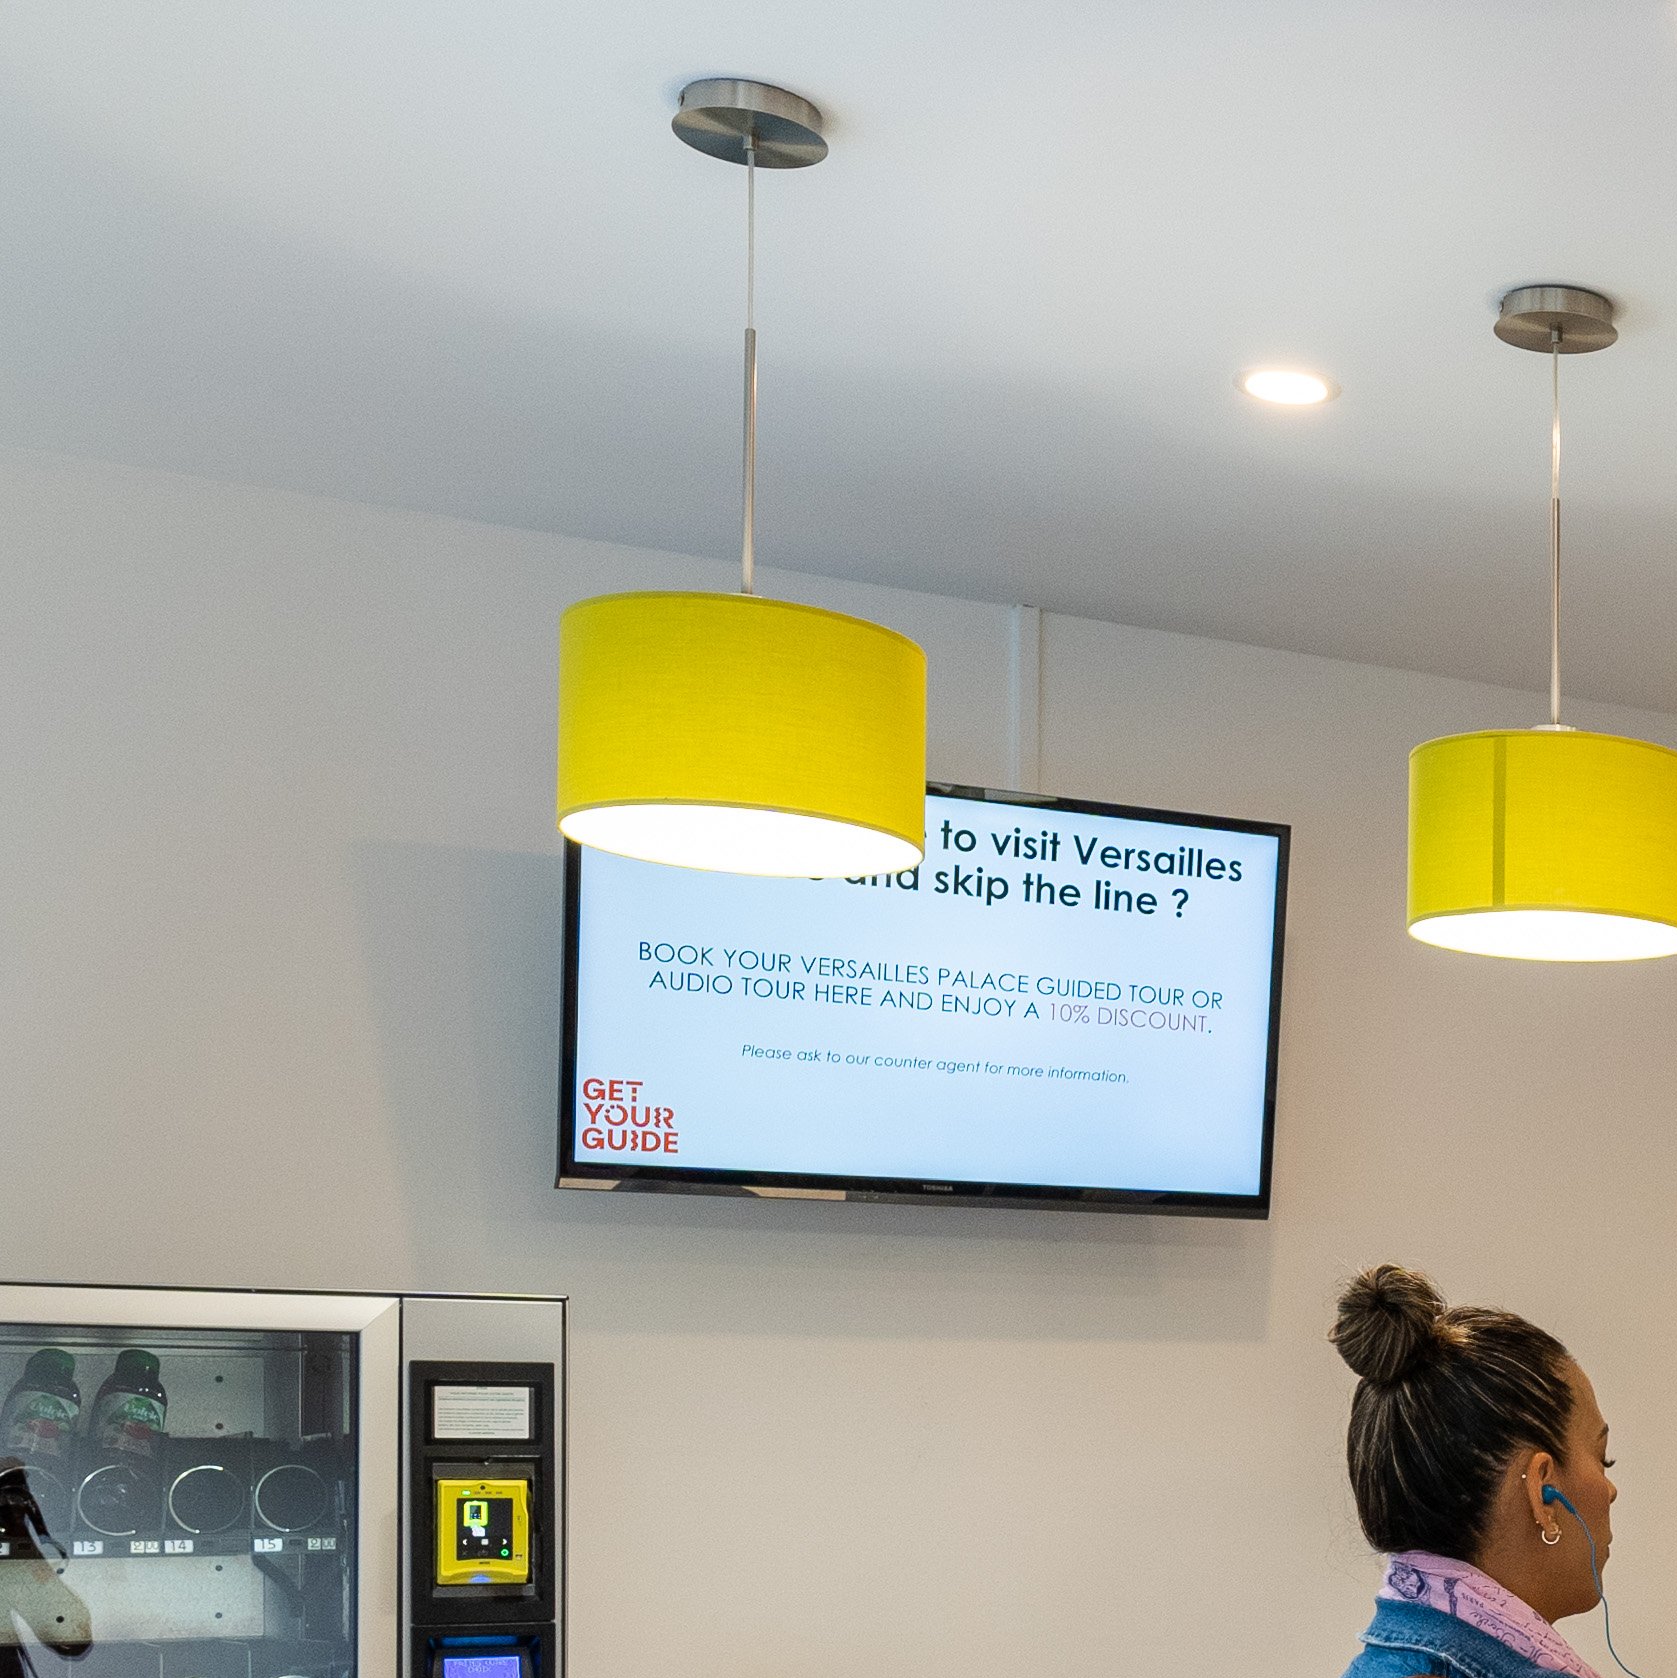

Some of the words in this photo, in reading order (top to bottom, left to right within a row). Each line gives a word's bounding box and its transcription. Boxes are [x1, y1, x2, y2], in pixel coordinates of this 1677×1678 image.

[941, 820, 976, 852] to
[991, 827, 1061, 865] visit
[1073, 835, 1243, 882] Versailles
[934, 865, 1009, 906] skip
[1023, 873, 1081, 907] the
[1094, 881, 1158, 915] line
[1172, 888, 1189, 918] ?
[639, 941, 714, 966] BOOK
[723, 949, 792, 973] YOUR
[800, 956, 929, 985] VERSAILLES
[938, 968, 1029, 993] PALACE
[1037, 976, 1122, 1001] GUIDED
[1129, 985, 1184, 1006] TOUR
[1192, 990, 1223, 1010] OR
[649, 971, 733, 995] AUDIO
[741, 977, 805, 1000] TOUR
[815, 984, 872, 1006] HERE
[880, 990, 933, 1011] AND
[942, 994, 1016, 1017] ENJOY
[1024, 1002, 1039, 1019] A
[1050, 1003, 1090, 1024] 10%
[1098, 1007, 1213, 1034] DISCOUNT.
[742, 1044, 792, 1060] Please
[797, 1050, 821, 1062] ask
[826, 1050, 841, 1063] to
[846, 1054, 871, 1064] our
[874, 1056, 932, 1070] counter
[936, 1060, 980, 1074] agent
[985, 1061, 1004, 1074] for
[1007, 1066, 1044, 1077] more
[1048, 1066, 1129, 1083] information.
[583, 1078, 643, 1102] GET
[583, 1103, 674, 1129] YOUR
[582, 1128, 678, 1153] GUIDE
